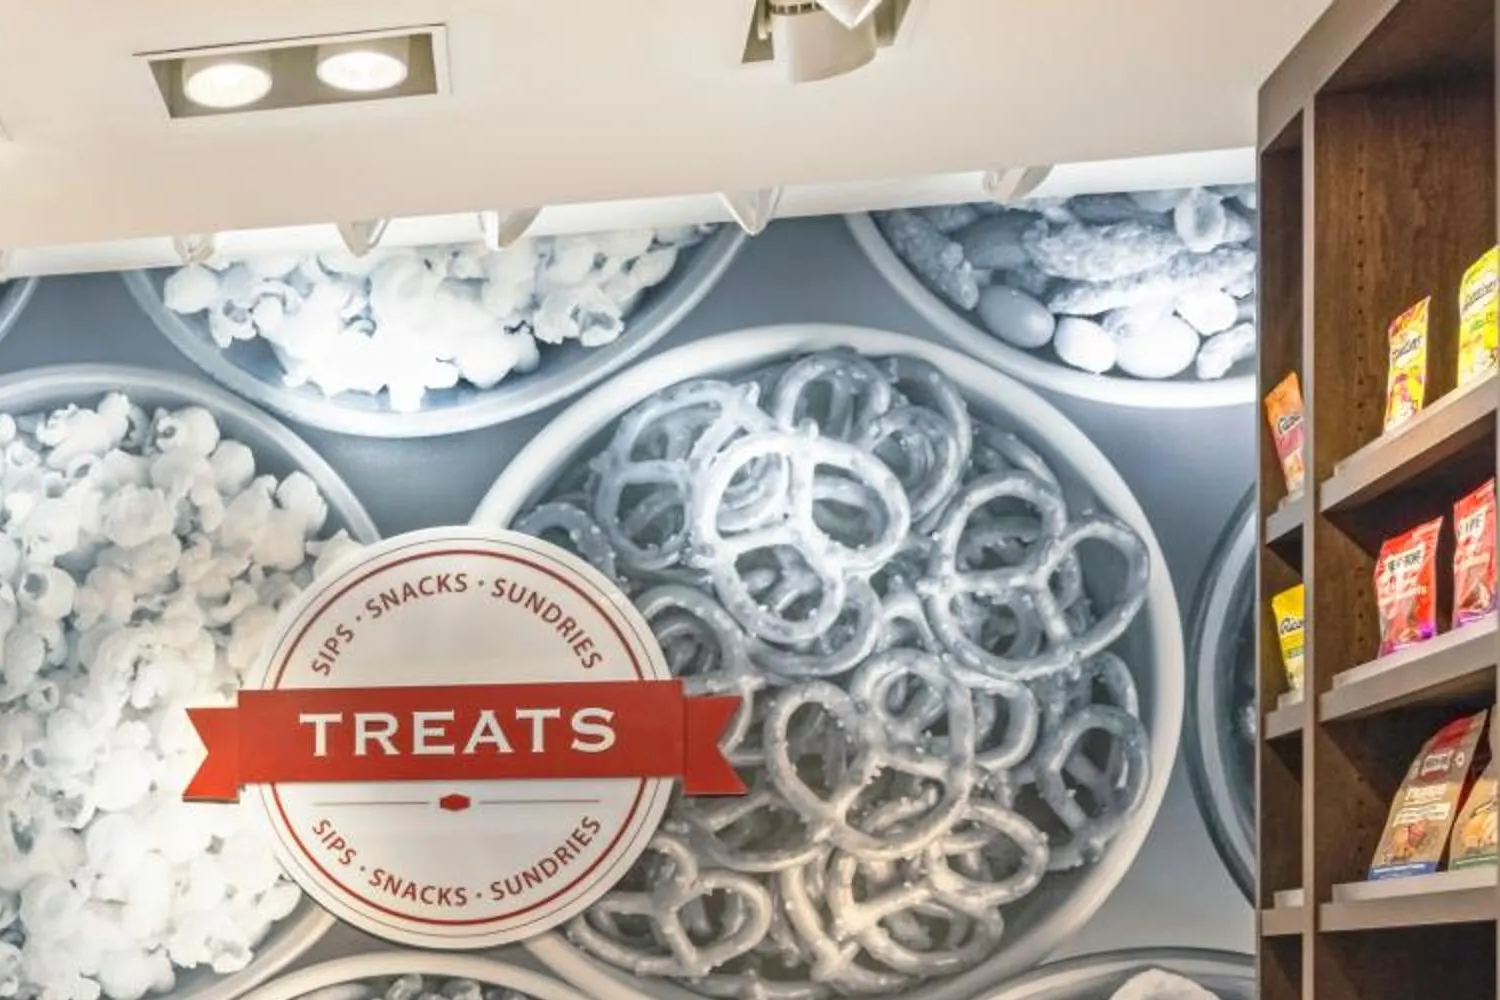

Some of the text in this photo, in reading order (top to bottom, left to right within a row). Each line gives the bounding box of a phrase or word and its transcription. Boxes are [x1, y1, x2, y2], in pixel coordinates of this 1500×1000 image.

[311, 572, 603, 676] SIPS SNACKS SUNDRIES
[299, 707, 617, 757] TREATS
[312, 815, 603, 907] SIPS SNACKS SUNDRIES
